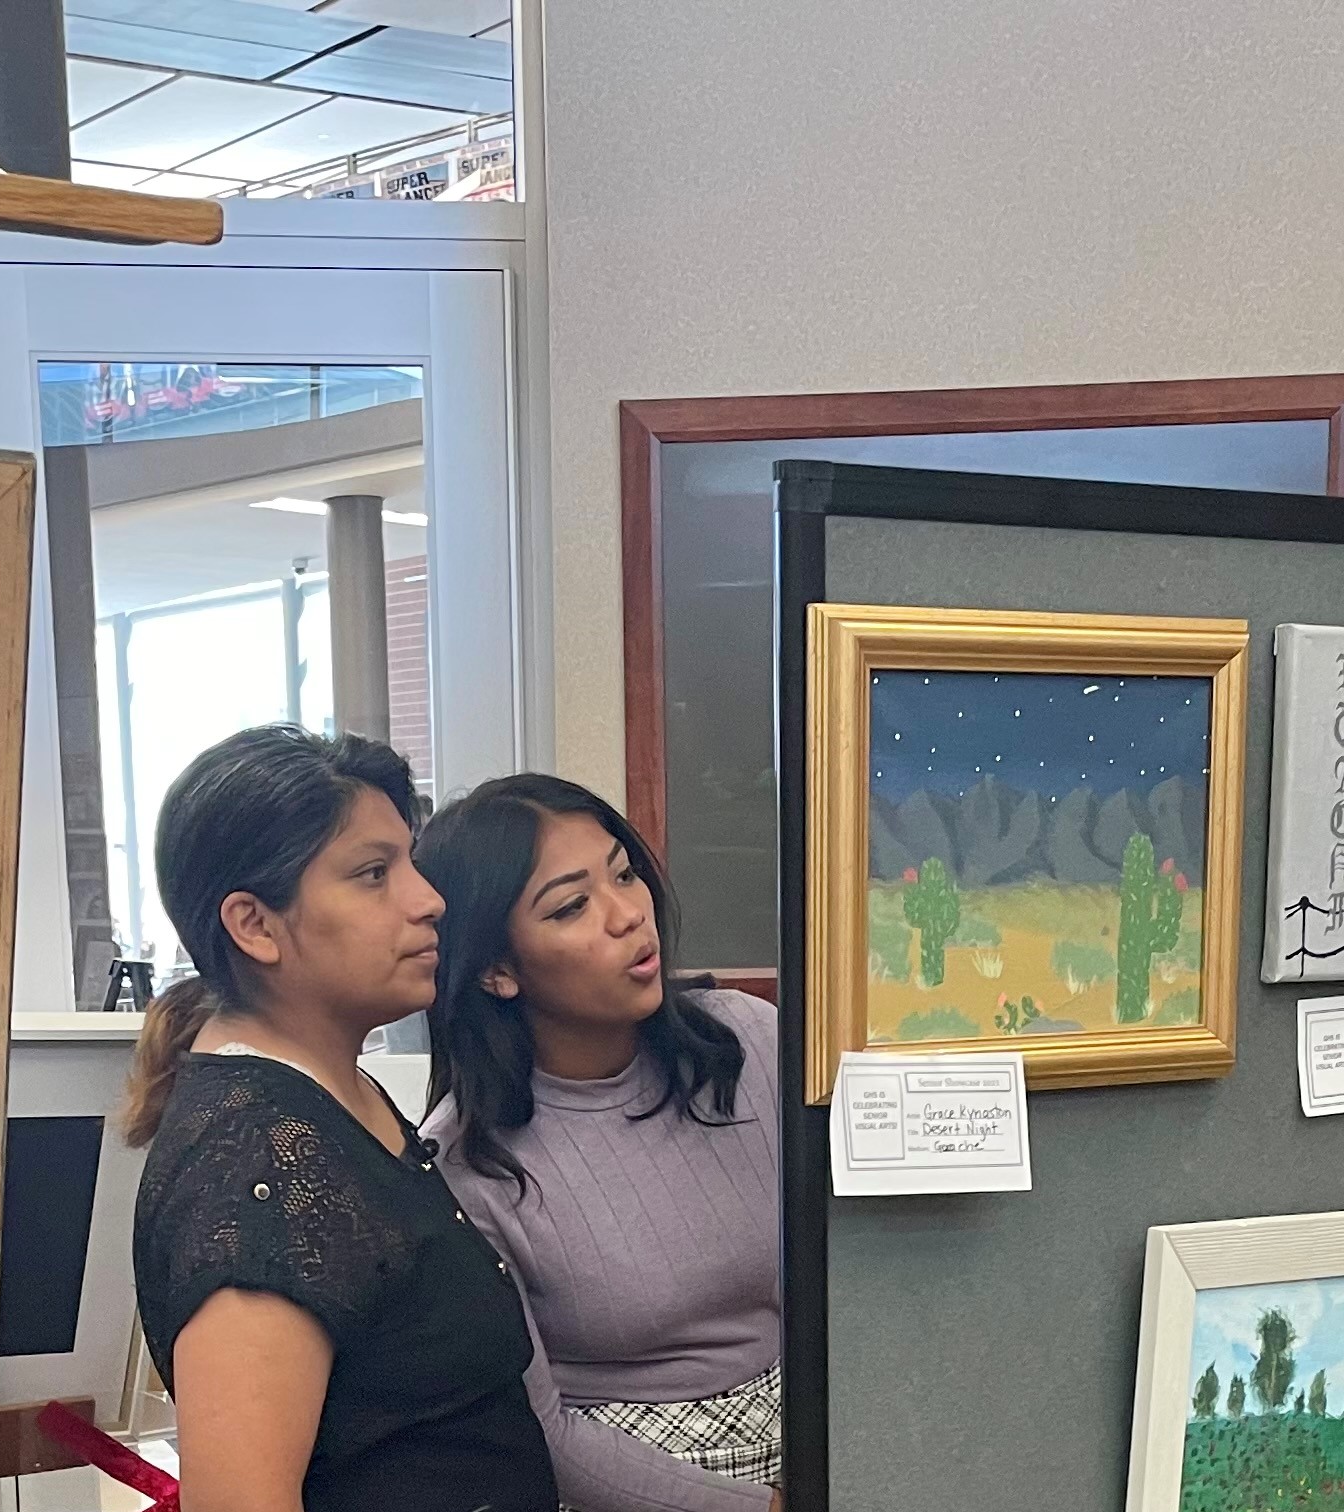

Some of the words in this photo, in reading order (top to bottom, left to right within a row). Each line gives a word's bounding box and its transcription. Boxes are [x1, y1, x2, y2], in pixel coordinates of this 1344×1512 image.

[386, 171, 430, 194] SUPER
[923, 1103, 955, 1120] Grace
[959, 1102, 1012, 1122] Kynaston
[922, 1122, 960, 1135] Desert
[966, 1122, 998, 1142] Night
